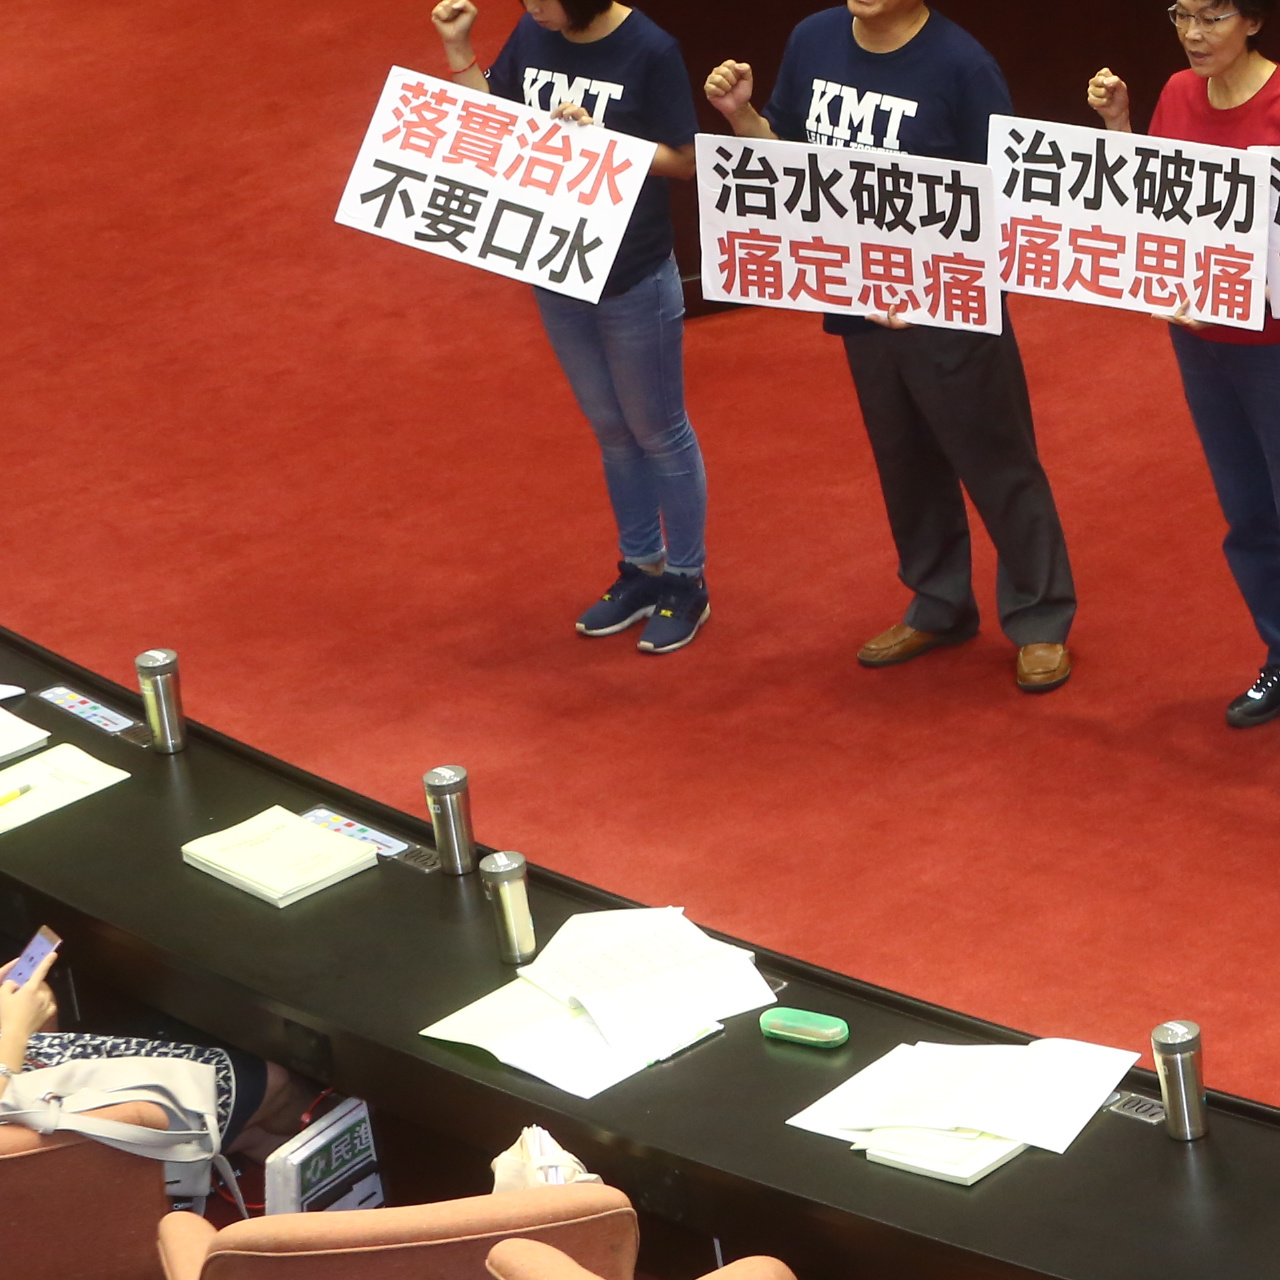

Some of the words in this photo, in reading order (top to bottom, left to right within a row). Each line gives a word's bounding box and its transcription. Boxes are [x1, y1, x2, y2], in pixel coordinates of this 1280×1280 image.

[381, 80, 634, 208] 落實治水
[523, 67, 624, 128] KMT
[806, 78, 918, 150] KMT
[359, 159, 603, 285] 不要口水
[714, 146, 982, 243] 治水破功
[1002, 128, 1255, 234] 治水破功
[717, 228, 988, 326] 痛定思痛
[998, 215, 1254, 321] 痛定思痛
